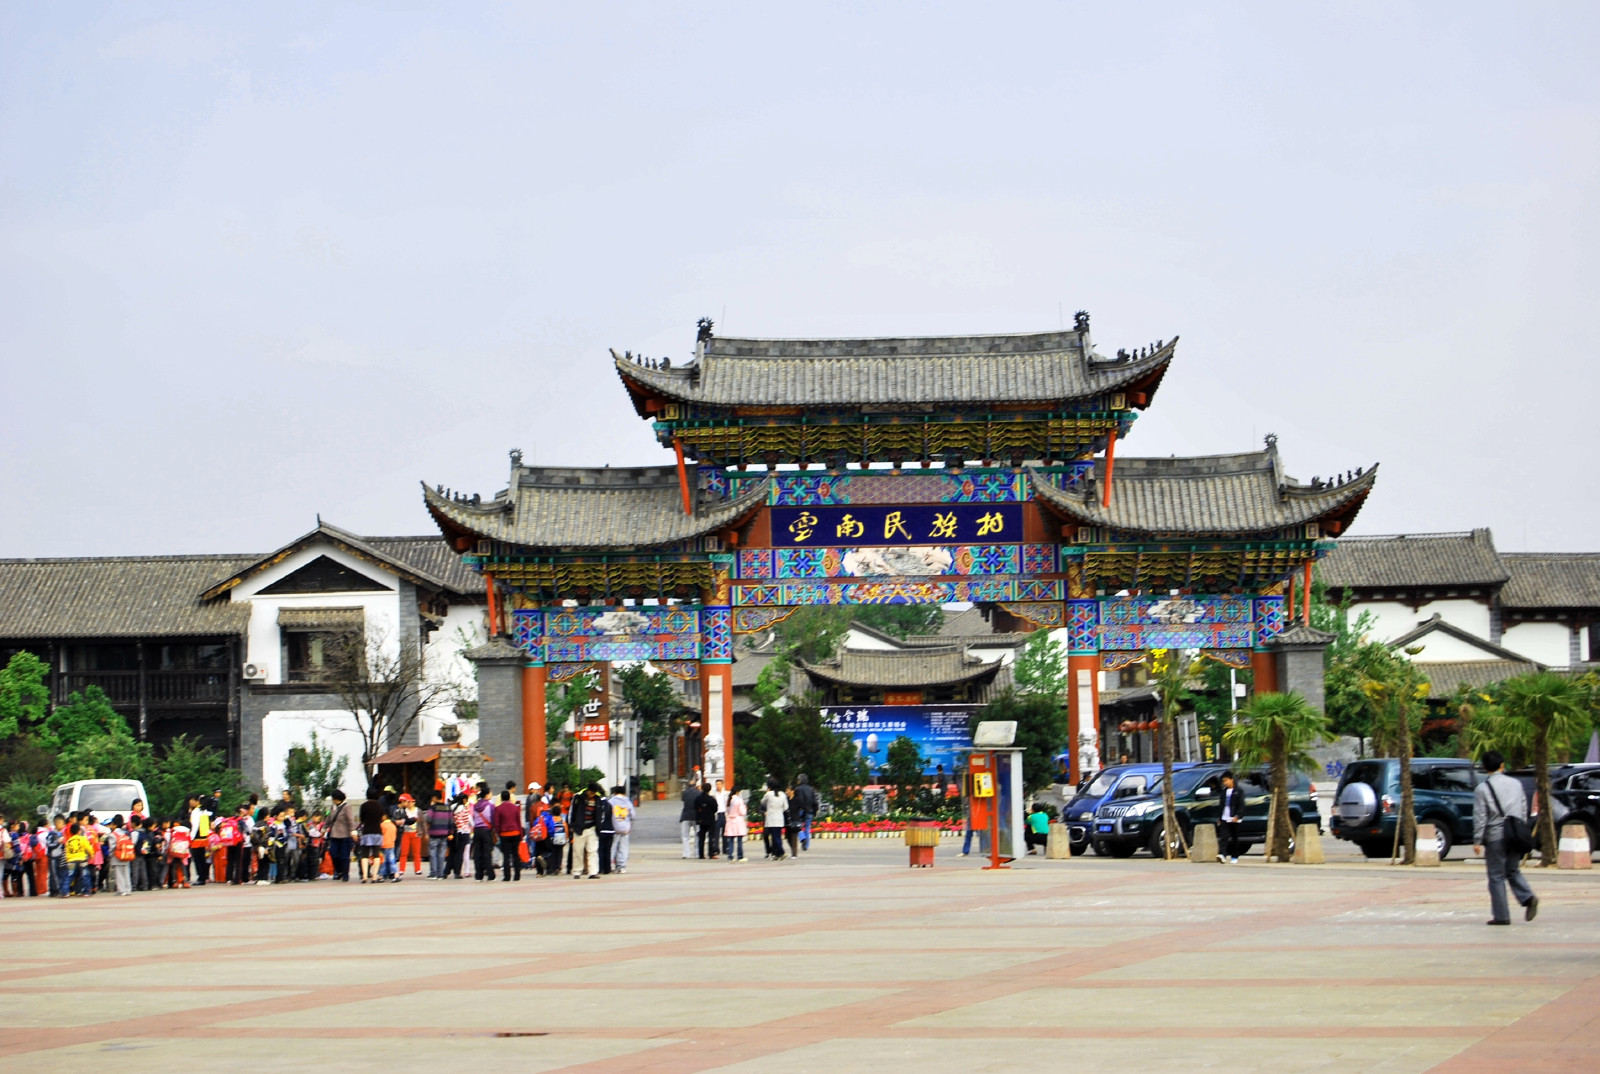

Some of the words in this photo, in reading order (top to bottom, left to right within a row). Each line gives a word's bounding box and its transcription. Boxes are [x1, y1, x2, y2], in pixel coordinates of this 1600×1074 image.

[788, 511, 1004, 542] 雲南民族村
